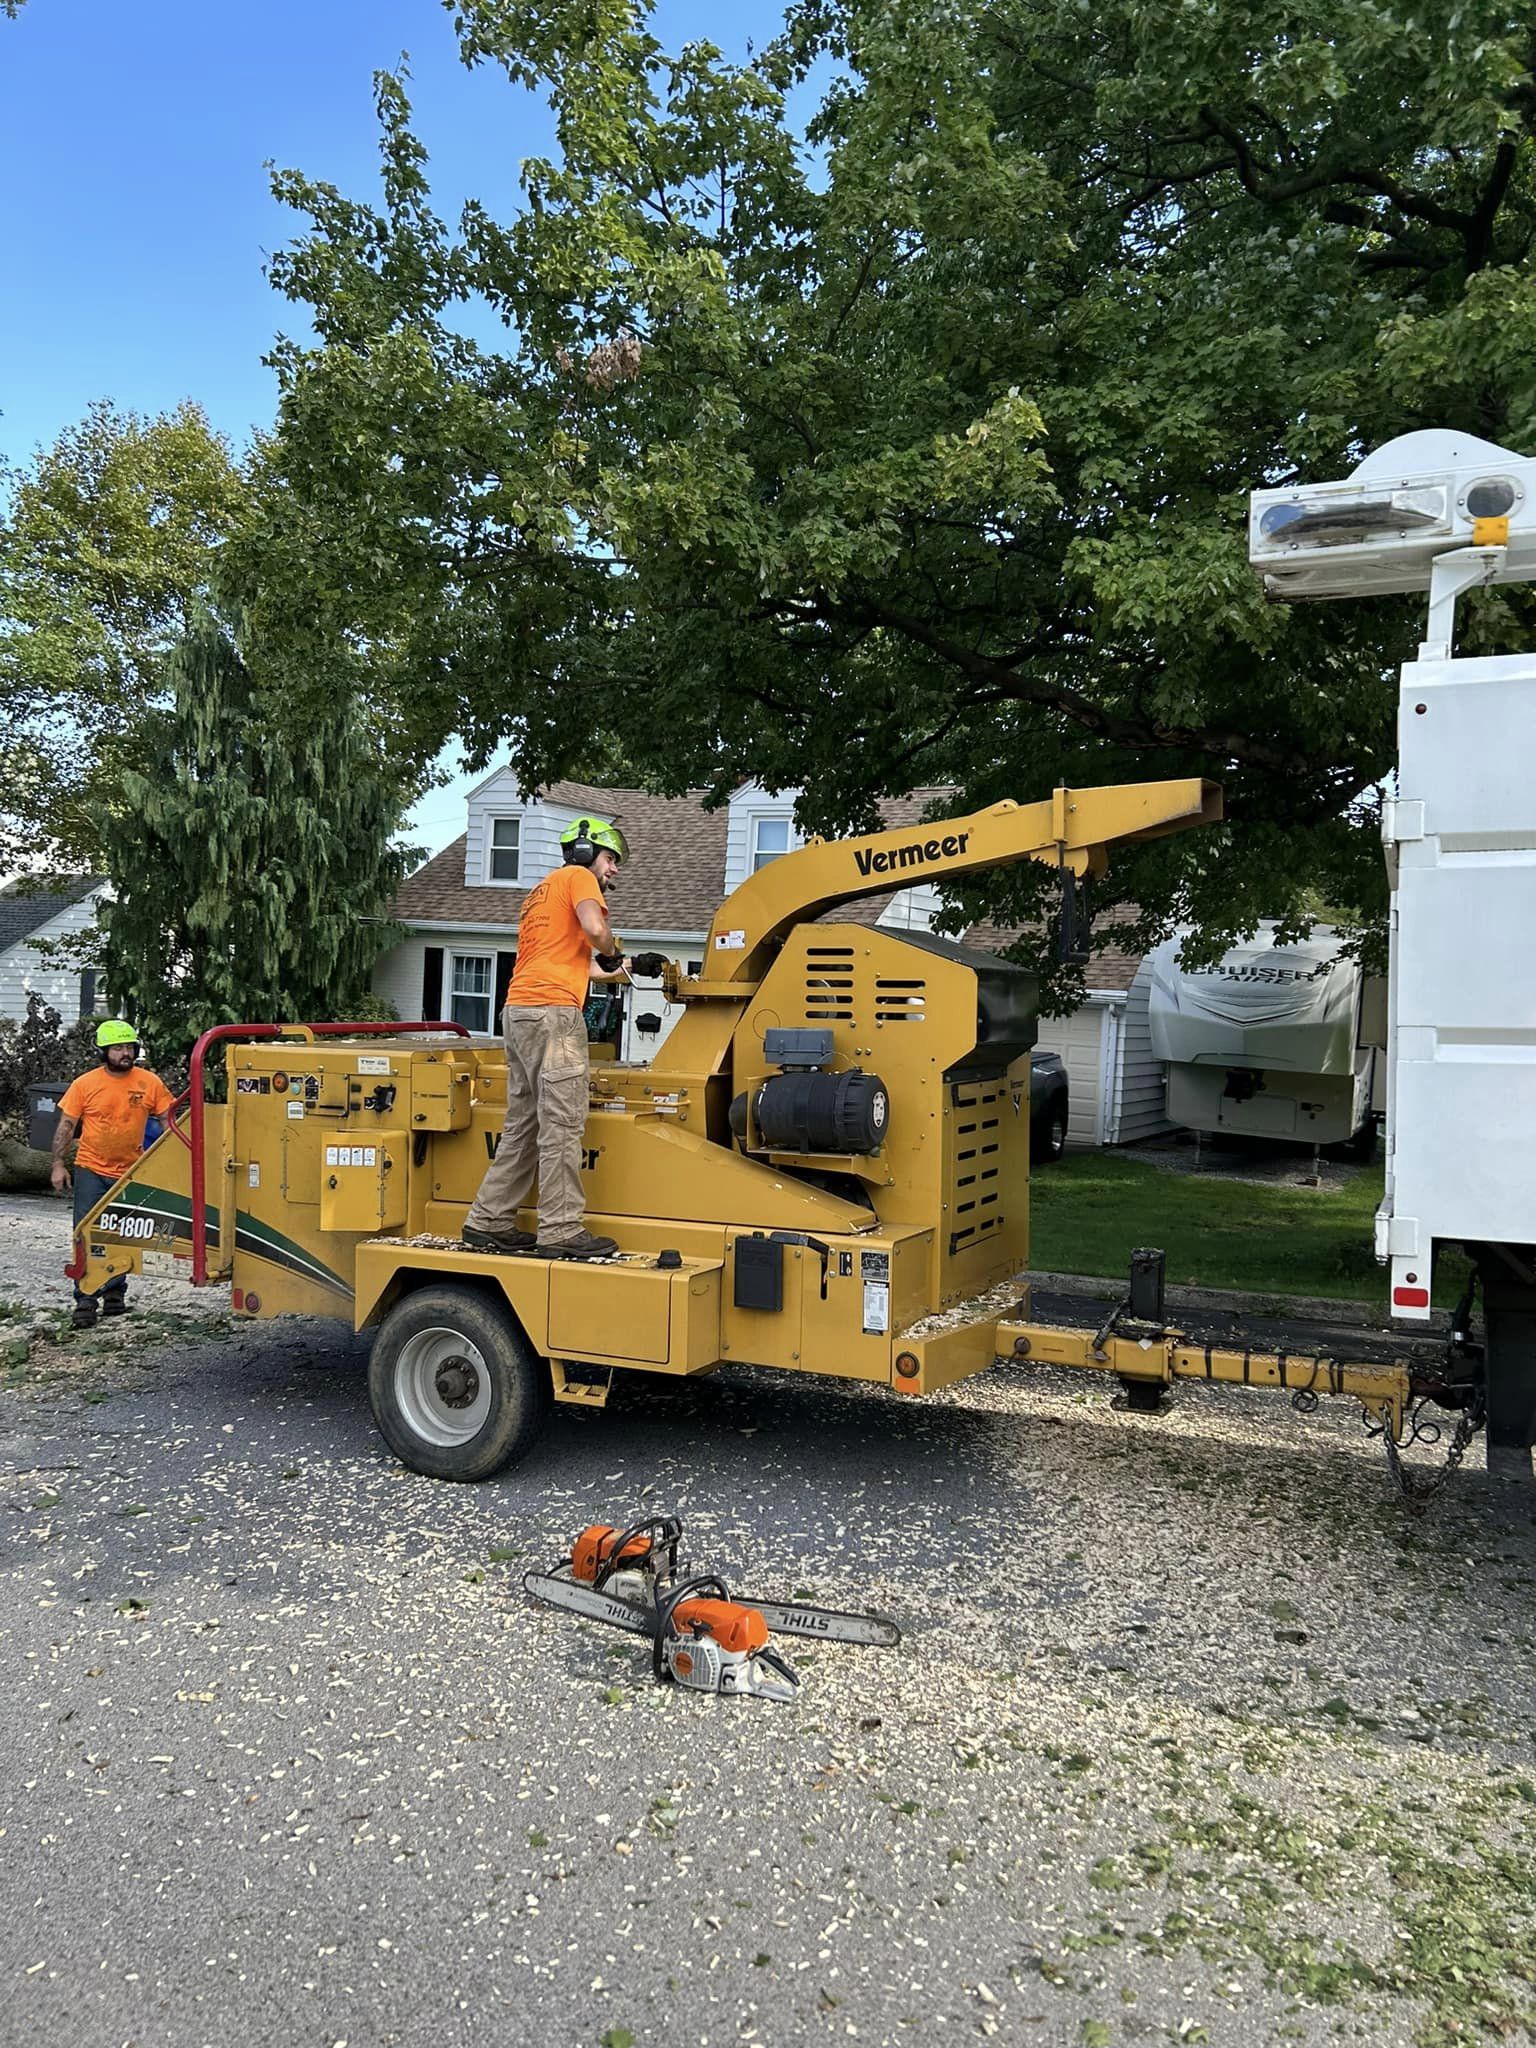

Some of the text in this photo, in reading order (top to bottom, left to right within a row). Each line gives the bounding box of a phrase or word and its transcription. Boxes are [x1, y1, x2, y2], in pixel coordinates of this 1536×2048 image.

[854, 833, 969, 876] Vermeer
[1221, 975, 1295, 986] AIRE
[779, 1611, 831, 1631] STIHL
